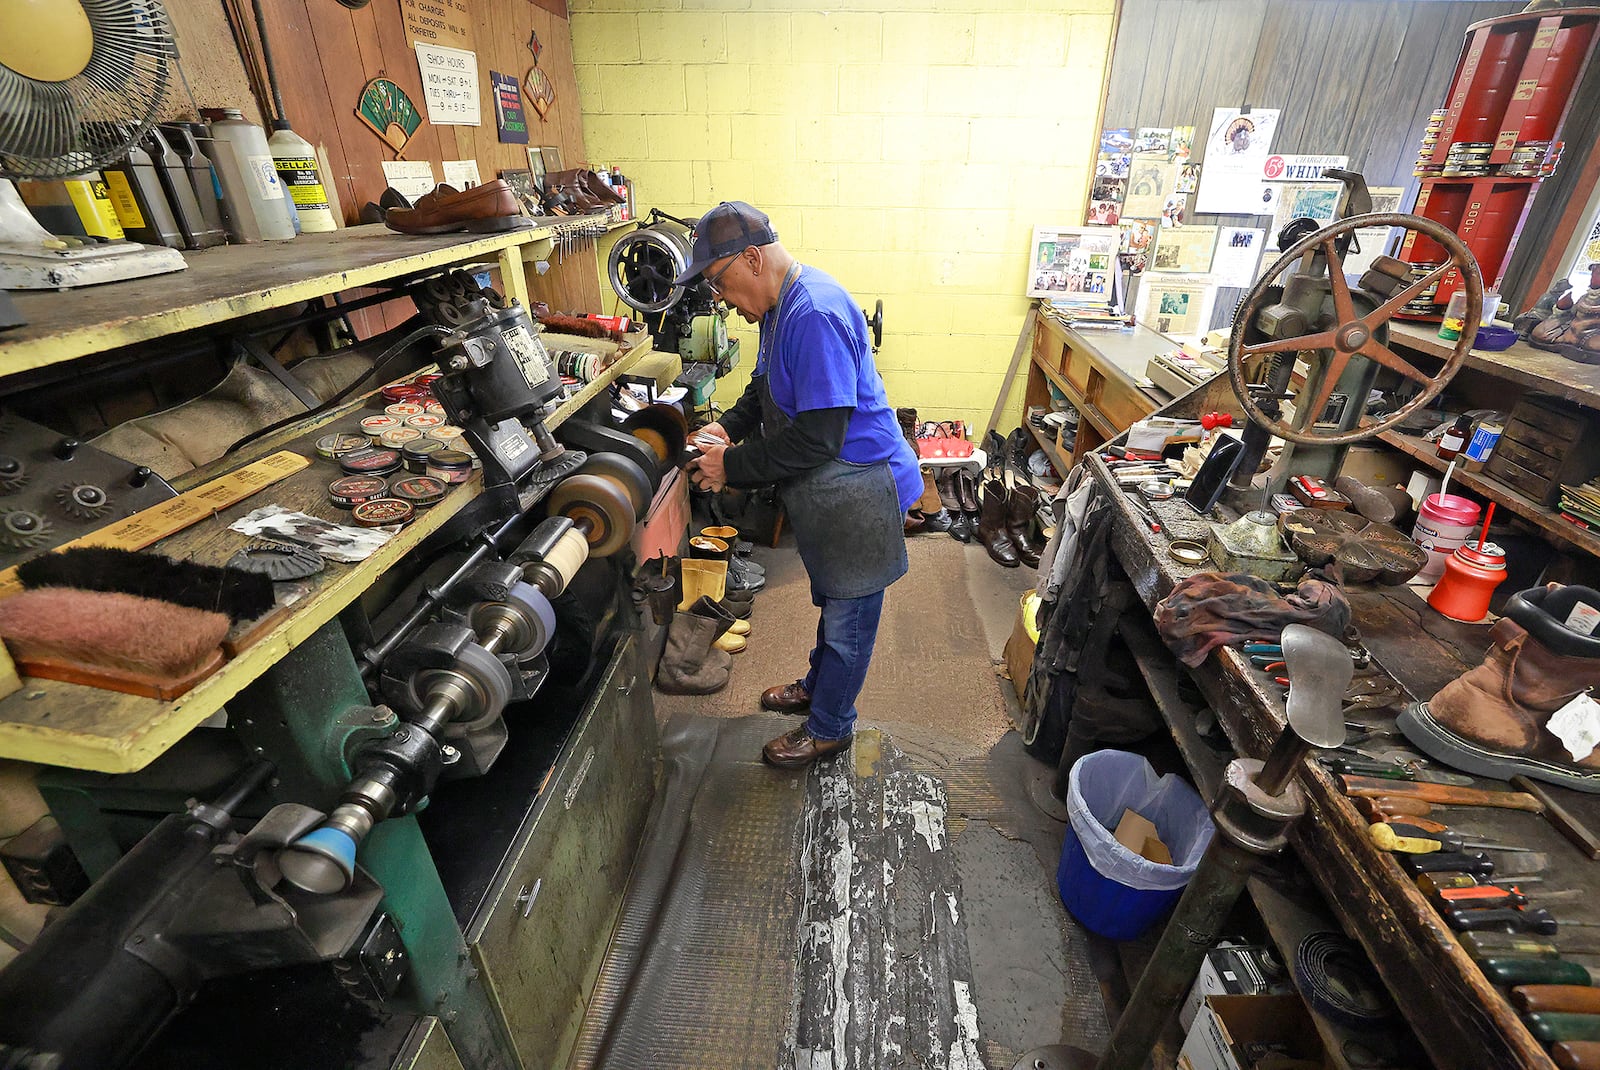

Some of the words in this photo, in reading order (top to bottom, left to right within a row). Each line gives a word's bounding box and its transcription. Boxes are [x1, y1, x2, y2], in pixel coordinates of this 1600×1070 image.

[418, 2, 446, 17] CHARGES
[407, 12, 417, 22] ALL
[419, 15, 446, 29] DEPOSITS
[427, 53, 445, 66] SHOP
[447, 56, 465, 69] HOURS
[1463, 49, 1481, 83] BOOT
[1441, 92, 1465, 143] POLISH
[1295, 156, 1323, 164] CHARGE
[1325, 156, 1340, 164] FOR
[1463, 202, 1481, 233] BOOT
[366, 502, 398, 511] KIWI
